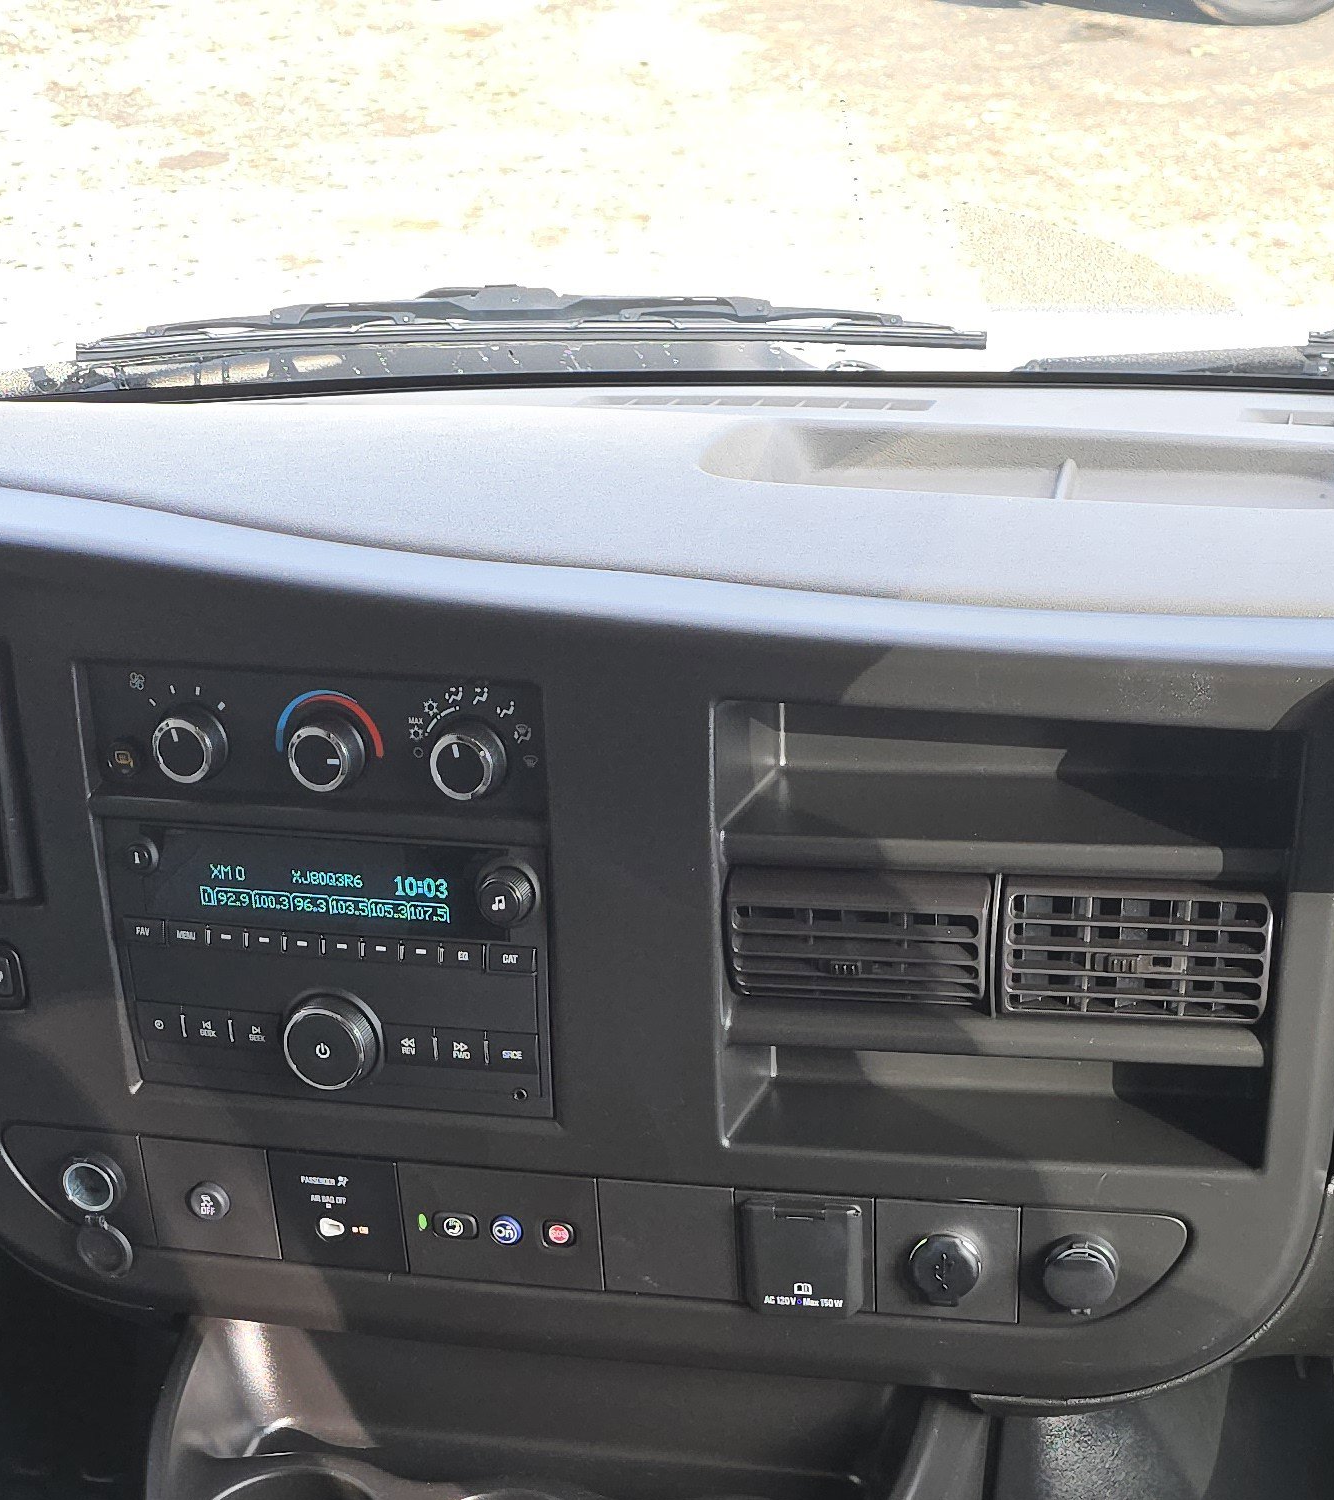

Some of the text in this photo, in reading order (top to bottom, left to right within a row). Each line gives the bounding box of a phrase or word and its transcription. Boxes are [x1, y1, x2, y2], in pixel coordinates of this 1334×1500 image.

[408, 716, 424, 725] MAX
[210, 864, 231, 880] XM
[394, 875, 449, 899] 10:03
[218, 891, 250, 906] 92.9
[255, 895, 290, 910] 100.3
[294, 898, 327, 913] 96.3
[331, 901, 368, 916] 103.5
[409, 906, 447, 922] 107.5
[135, 926, 150, 936] FAV
[502, 953, 519, 964] CAT
[452, 1050, 471, 1060] FWD
[201, 1207, 216, 1216] OFF
[764, 1295, 775, 1304] AC
